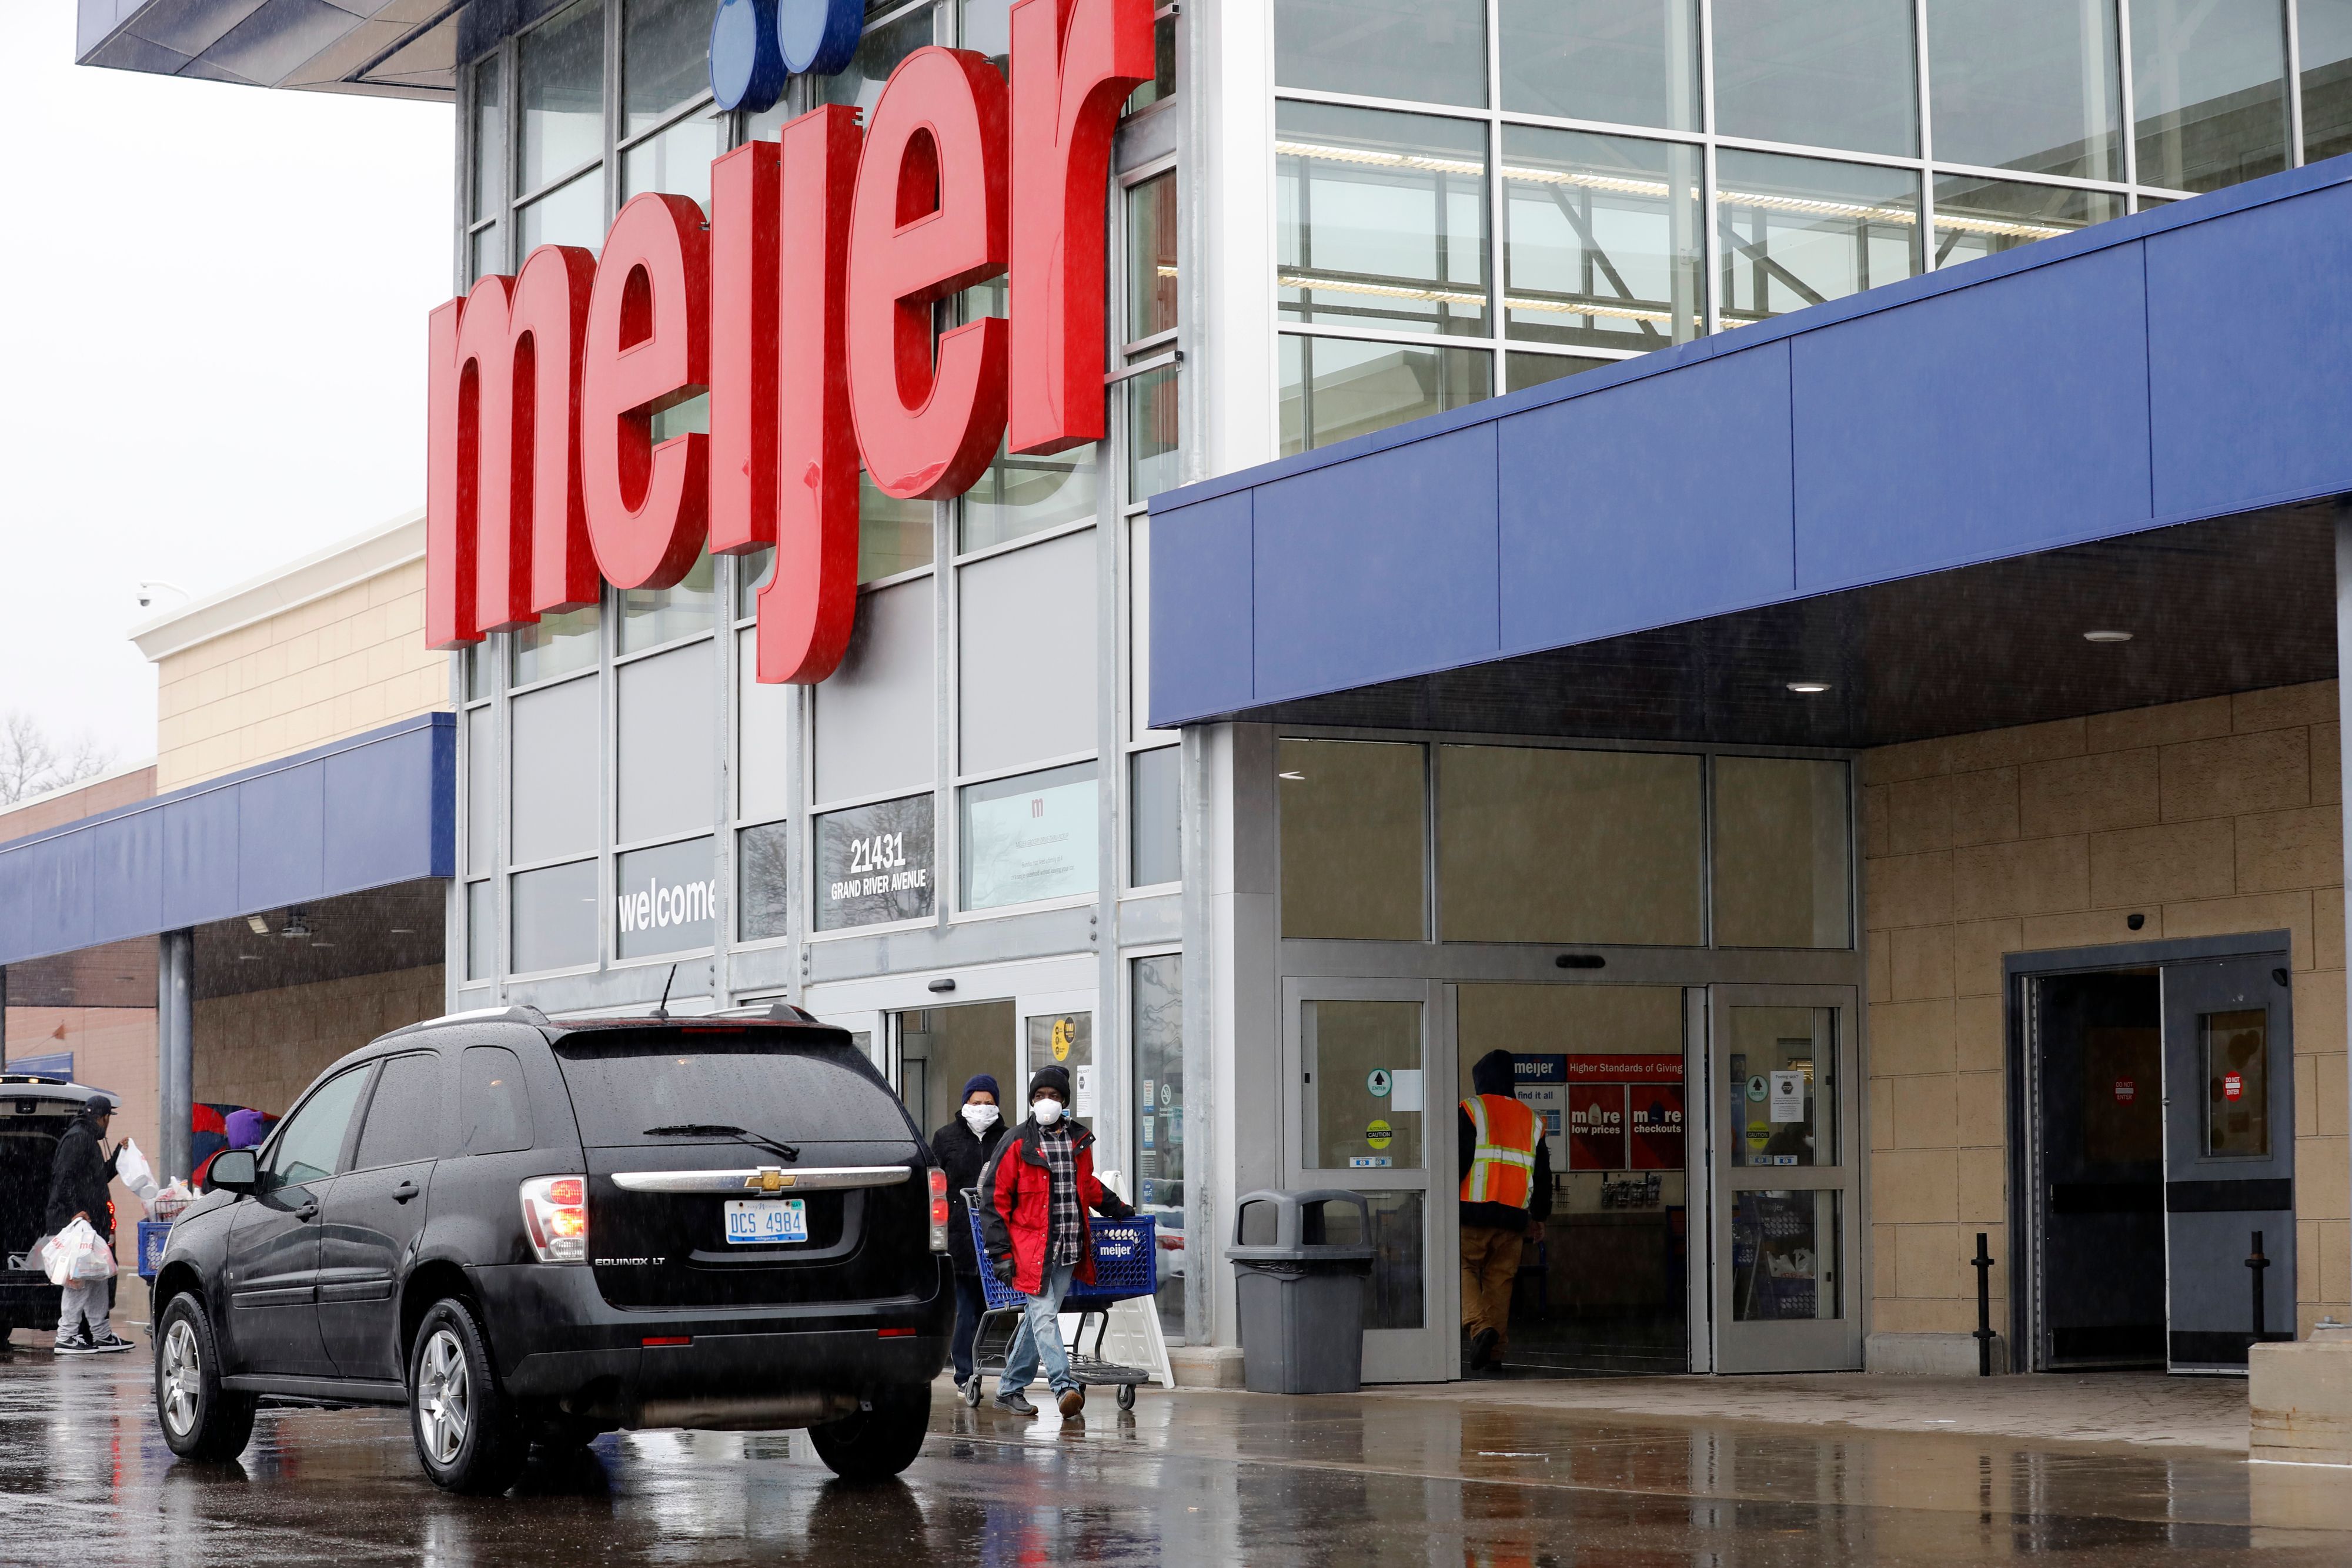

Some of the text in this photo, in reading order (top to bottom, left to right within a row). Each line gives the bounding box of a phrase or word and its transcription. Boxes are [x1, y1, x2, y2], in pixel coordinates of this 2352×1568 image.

[426, 0, 1154, 684] meijer
[1031, 798, 1044, 818] m
[850, 832, 906, 874] 21431
[831, 868, 927, 901] GRAND RIVER AVENUE
[618, 877, 715, 932] welcome
[1514, 1059, 1683, 1076] meijer Higher Standards of Giving
[1518, 1091, 1553, 1099] find it all
[1572, 1124, 1621, 1135] low prices
[1633, 1124, 1682, 1134] checkouts
[730, 1212, 800, 1233] DCS 4984
[1100, 1243, 1131, 1258] meijer
